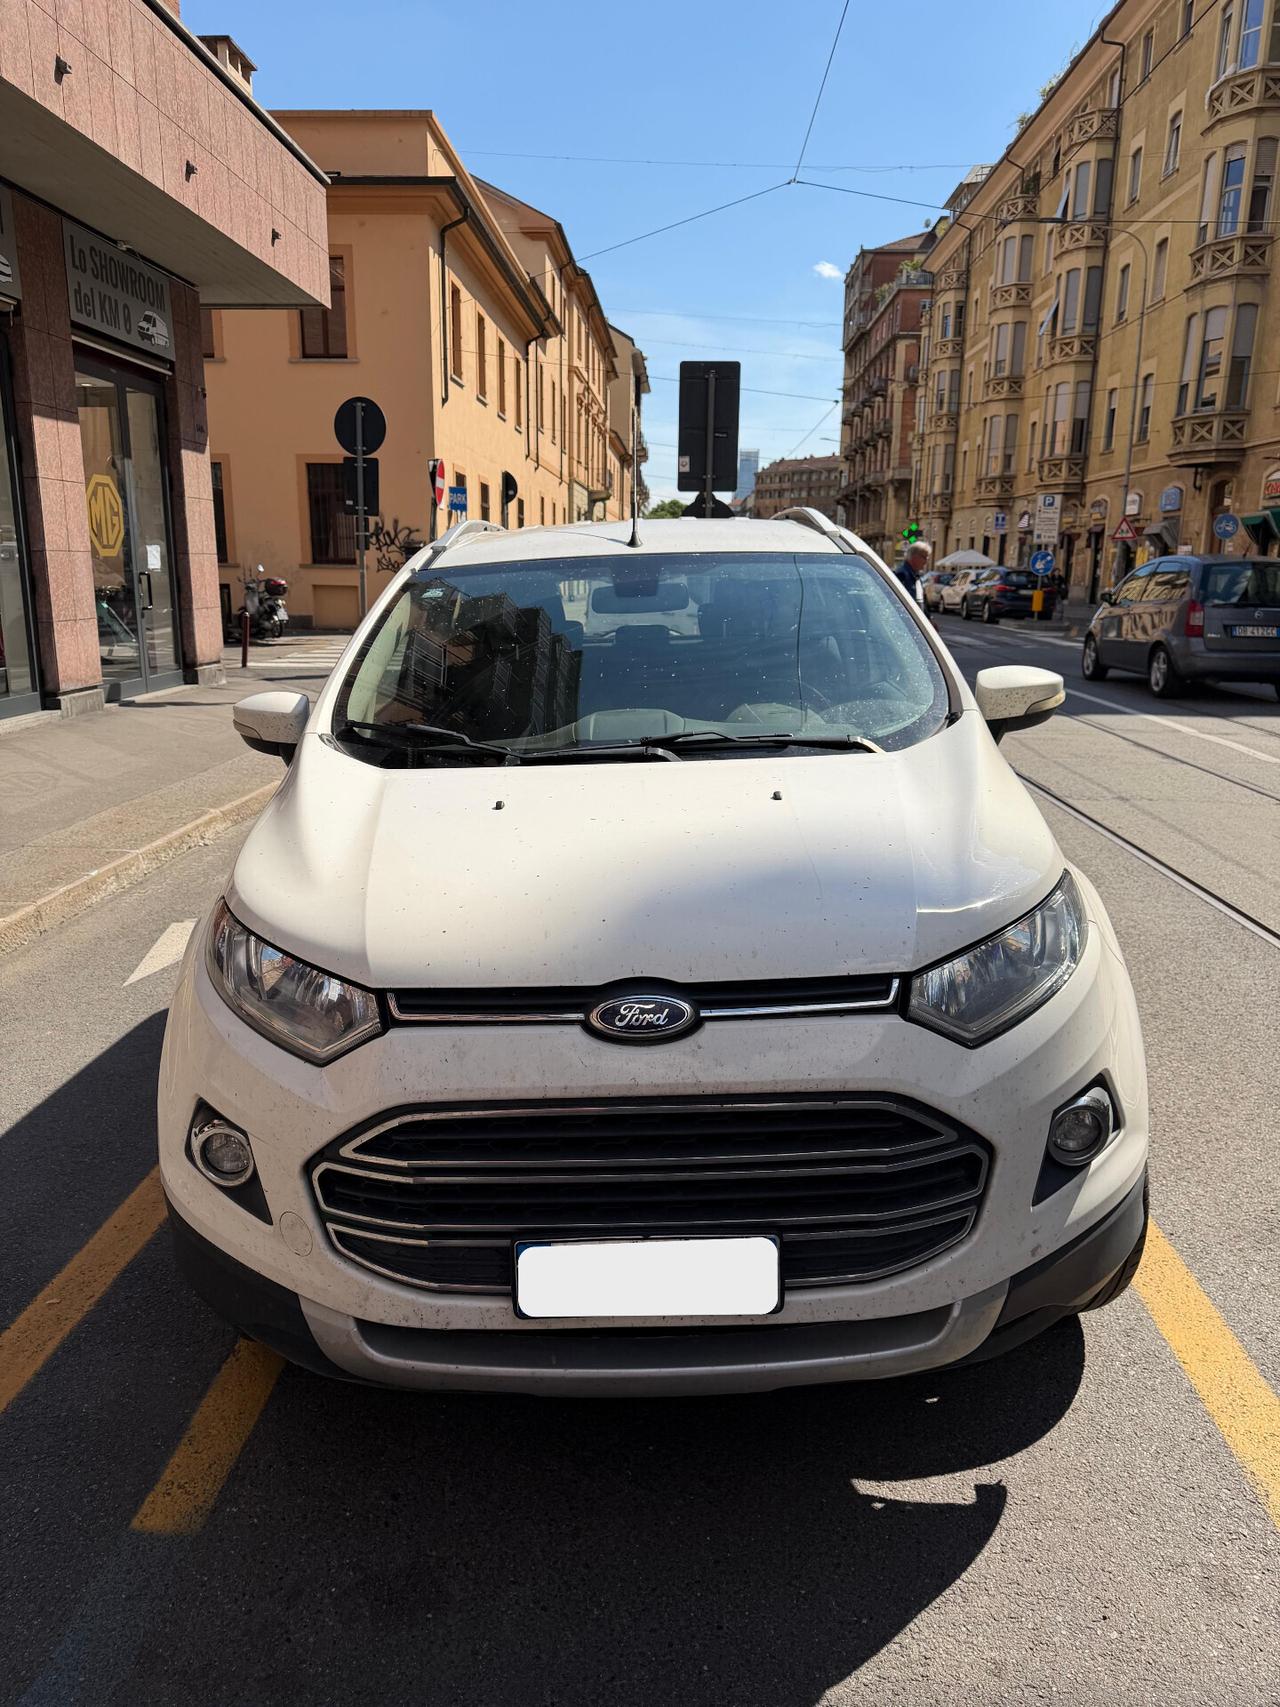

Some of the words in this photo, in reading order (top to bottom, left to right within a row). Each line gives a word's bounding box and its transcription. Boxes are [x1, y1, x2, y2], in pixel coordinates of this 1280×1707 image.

[70, 235, 87, 274] Lo
[90, 245, 166, 313] SHOWROOM
[74, 281, 96, 320] del
[98, 291, 121, 330] KM
[90, 485, 121, 545] MG
[614, 1003, 670, 1027] Ford
